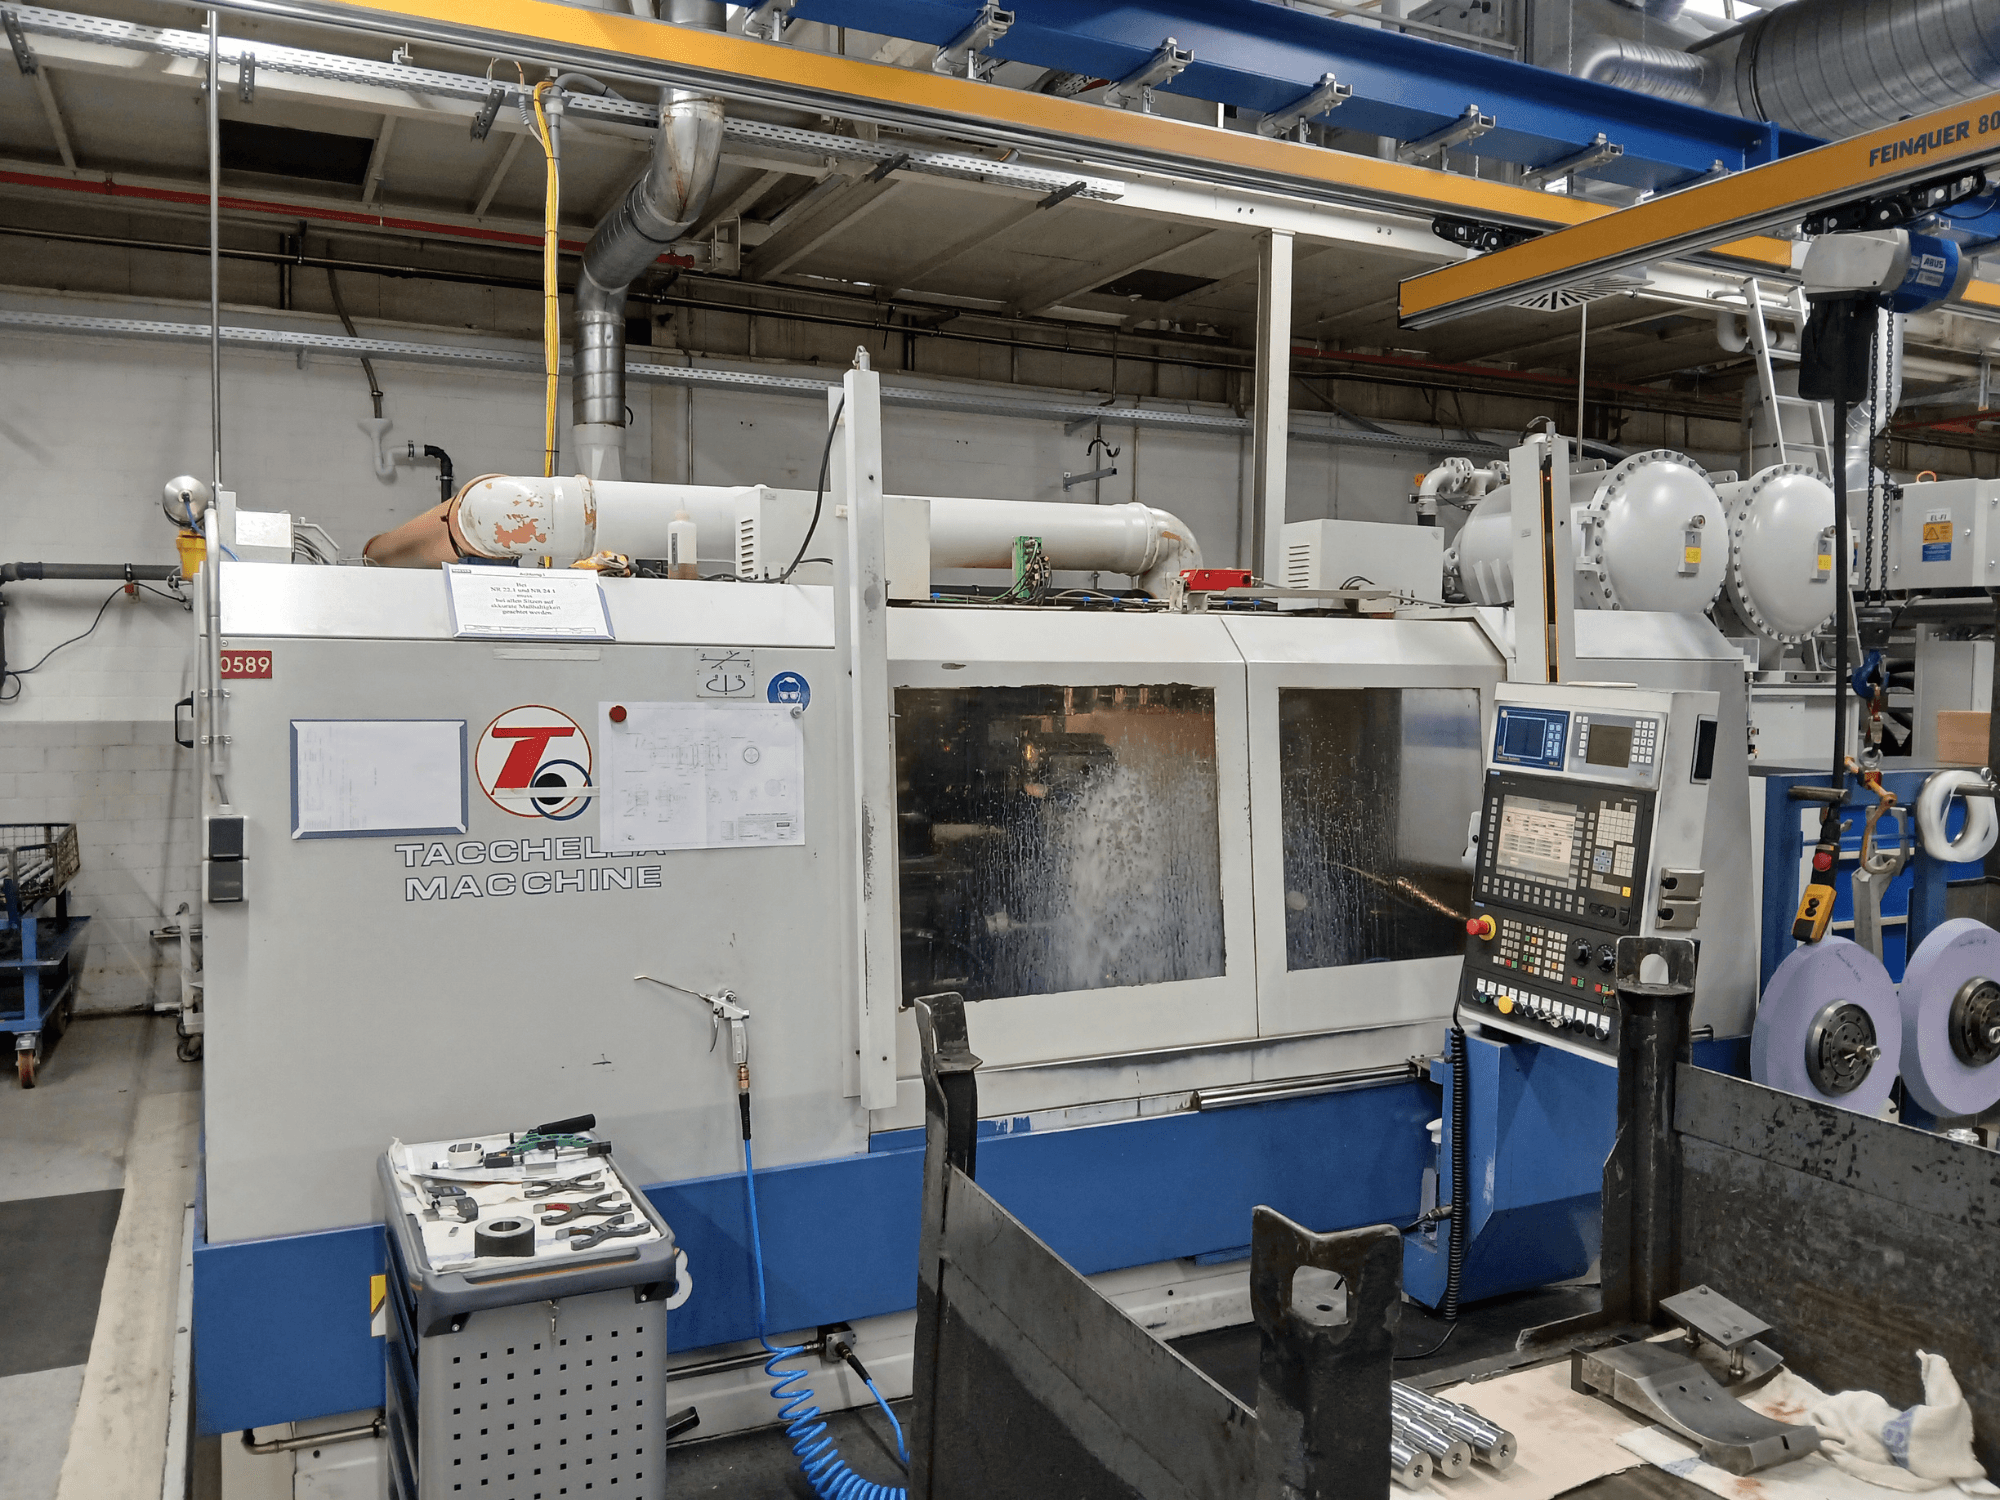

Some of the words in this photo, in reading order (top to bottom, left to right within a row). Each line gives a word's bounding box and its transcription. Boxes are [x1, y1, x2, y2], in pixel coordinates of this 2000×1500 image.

[1869, 120, 1970, 167] FEINAUER
[1923, 257, 1944, 269] ABUS
[220, 656, 271, 673] 0589
[394, 836, 666, 868] TACCHEL
[404, 865, 662, 902] MACCHINE
